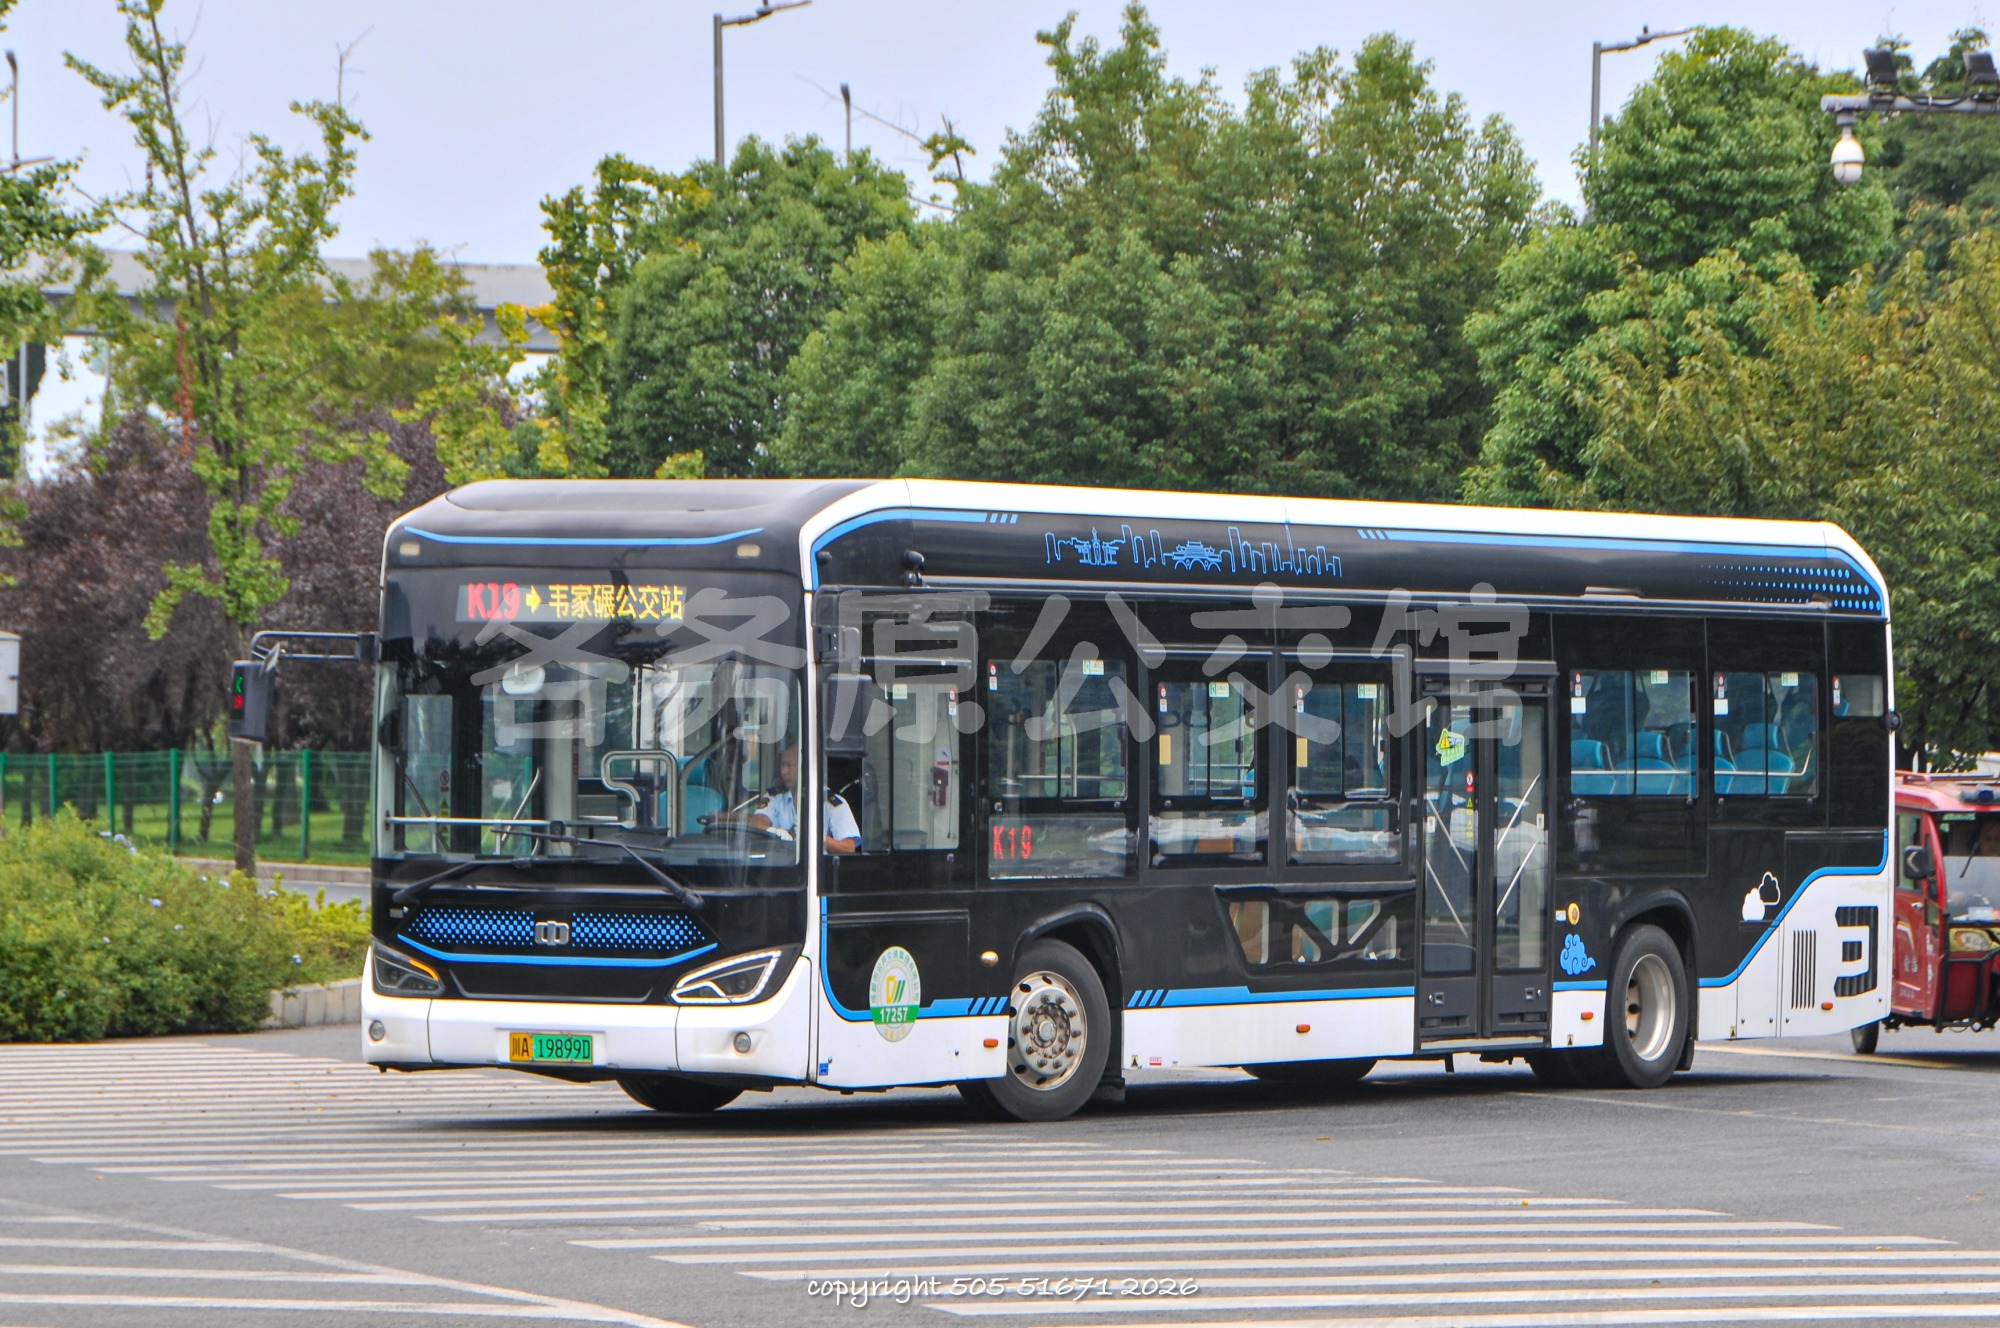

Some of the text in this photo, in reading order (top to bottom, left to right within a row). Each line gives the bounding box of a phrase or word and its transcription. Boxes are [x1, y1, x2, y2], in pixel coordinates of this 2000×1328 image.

[467, 582, 684, 620] K19 韦家碾公交站
[993, 825, 1033, 859] K19
[880, 1007, 908, 1023] 17257
[538, 1038, 591, 1060] 19899D
